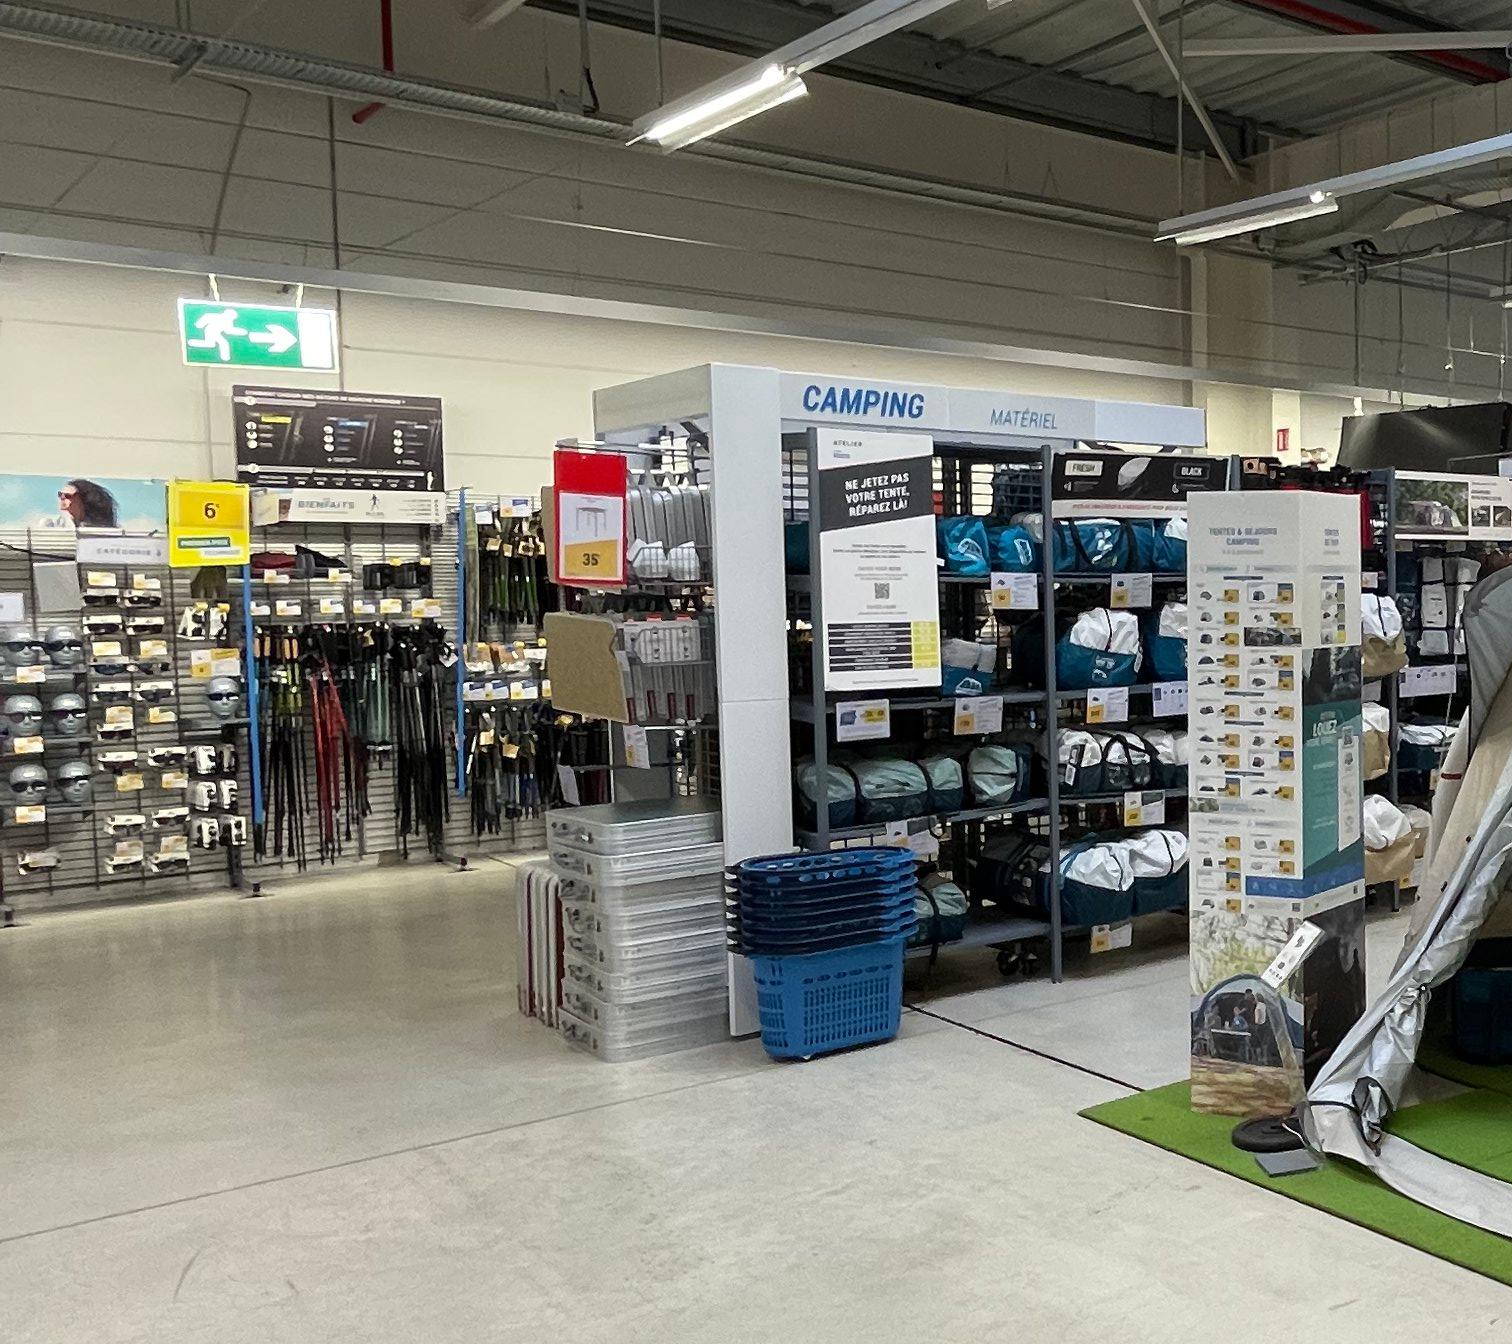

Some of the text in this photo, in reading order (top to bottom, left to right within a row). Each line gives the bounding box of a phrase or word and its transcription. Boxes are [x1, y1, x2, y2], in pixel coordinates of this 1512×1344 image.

[803, 384, 924, 419] CAMPING
[990, 408, 1058, 429] MATÉRIEL
[1181, 466, 1203, 477] BLACK
[845, 472, 910, 490] NE JETEZ PAS
[845, 490, 877, 504] VOTRE
[848, 503, 891, 517] RÉPAREZ
